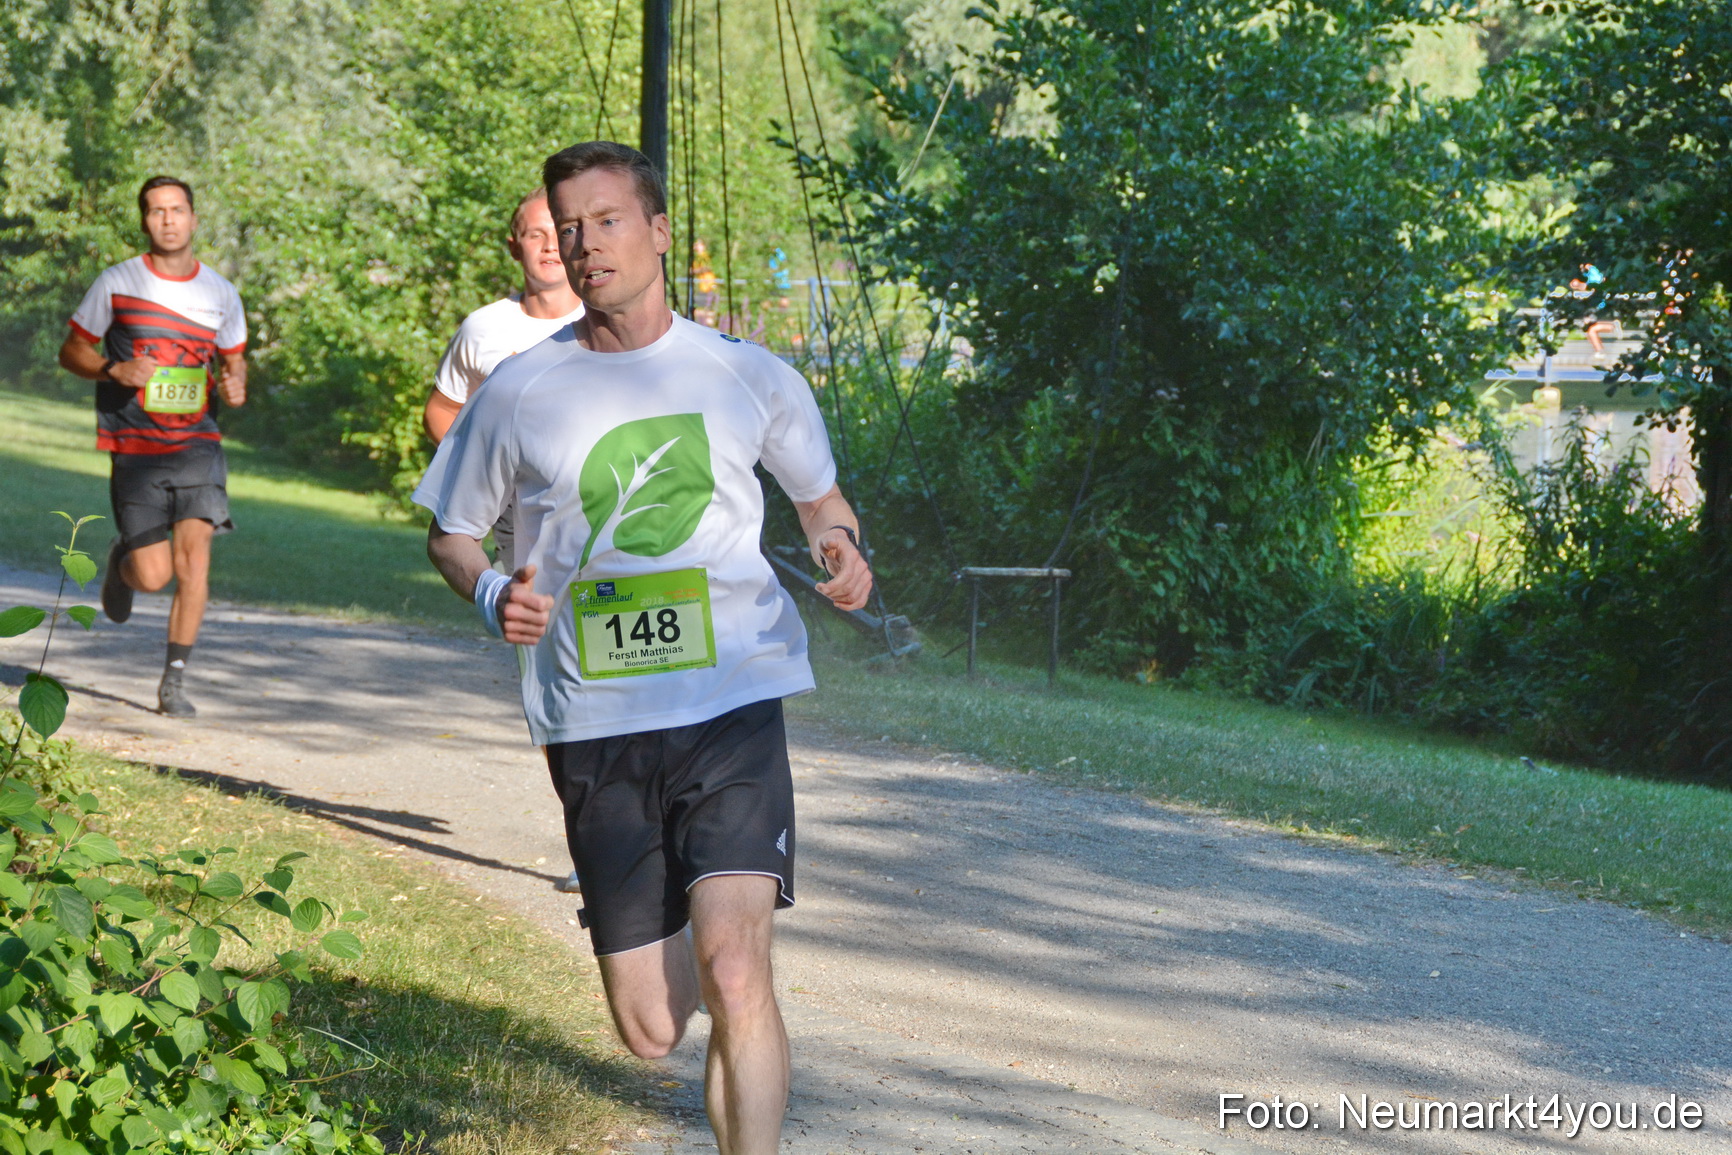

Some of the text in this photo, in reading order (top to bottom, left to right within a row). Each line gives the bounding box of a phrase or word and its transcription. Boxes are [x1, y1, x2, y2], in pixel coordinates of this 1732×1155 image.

[155, 384, 198, 400] 1878
[589, 592, 634, 605] firmenlauf
[605, 608, 681, 649] 148
[608, 645, 684, 661] Ferstl Matthias
[624, 659, 657, 668] Bionorica
